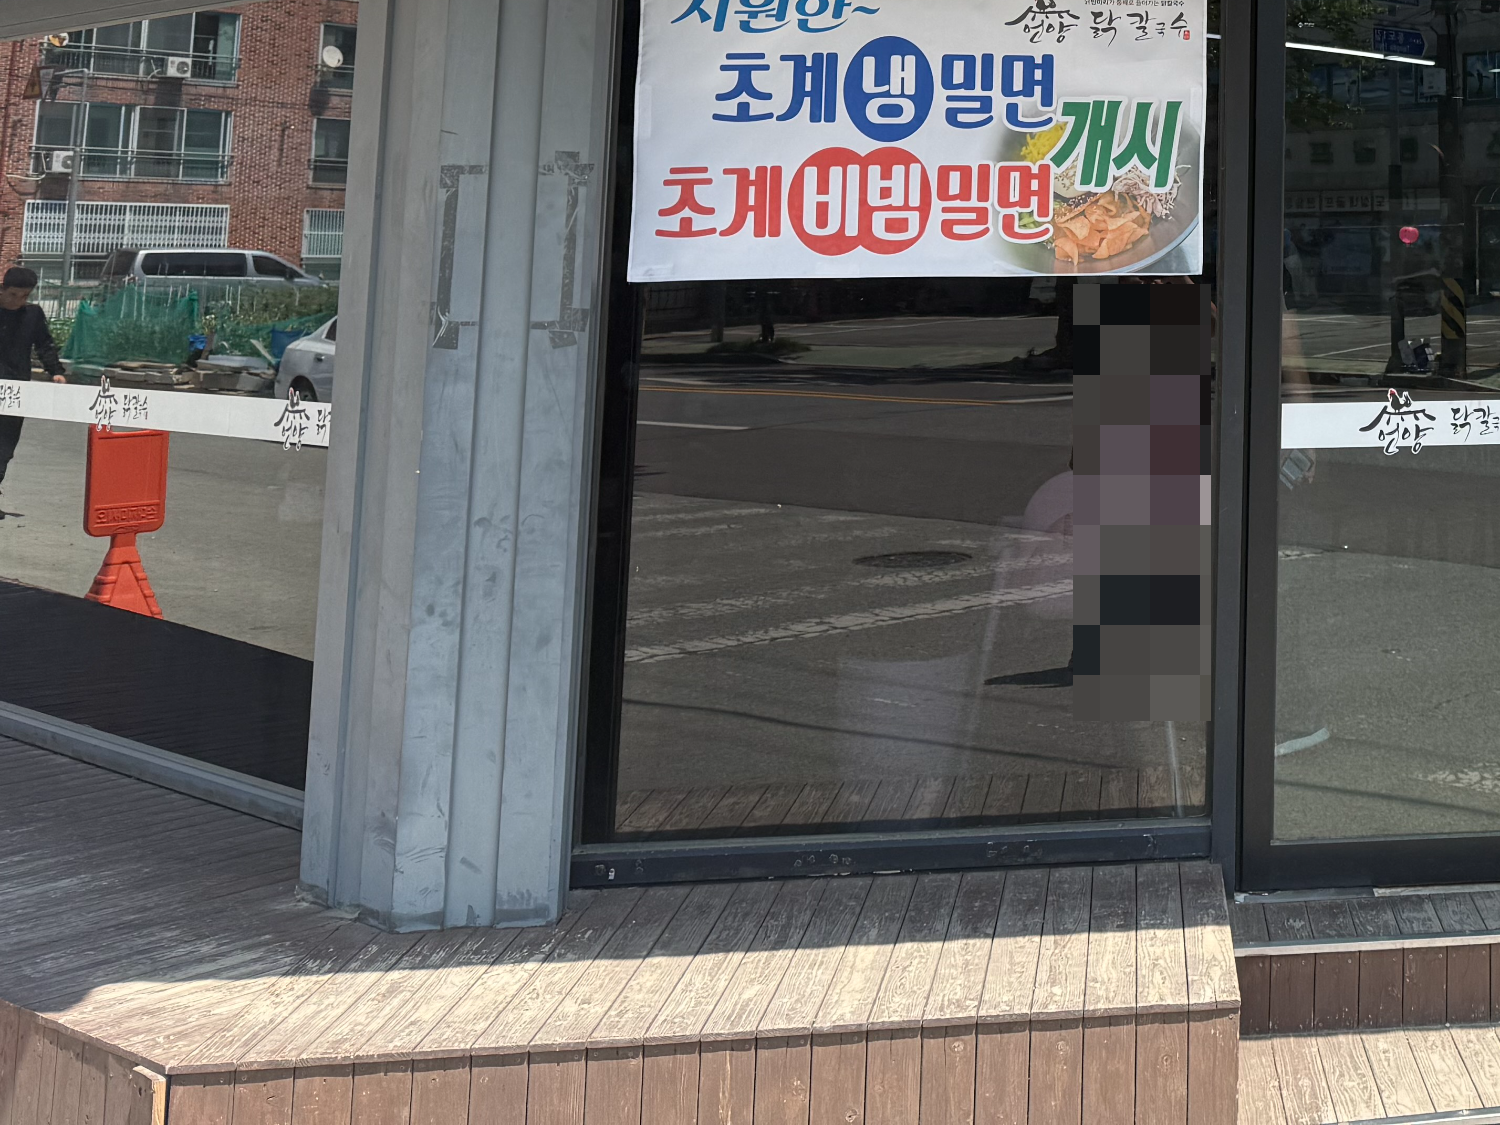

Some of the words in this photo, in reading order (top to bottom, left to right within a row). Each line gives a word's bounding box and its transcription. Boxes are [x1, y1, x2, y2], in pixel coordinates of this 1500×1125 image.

[1023, 19, 1078, 44] 언양
[711, 51, 1056, 131] 초계냉밀면
[1049, 98, 1185, 191] 개시
[654, 163, 1053, 242] 초계비빔밀면
[1377, 424, 1435, 455] 언양
